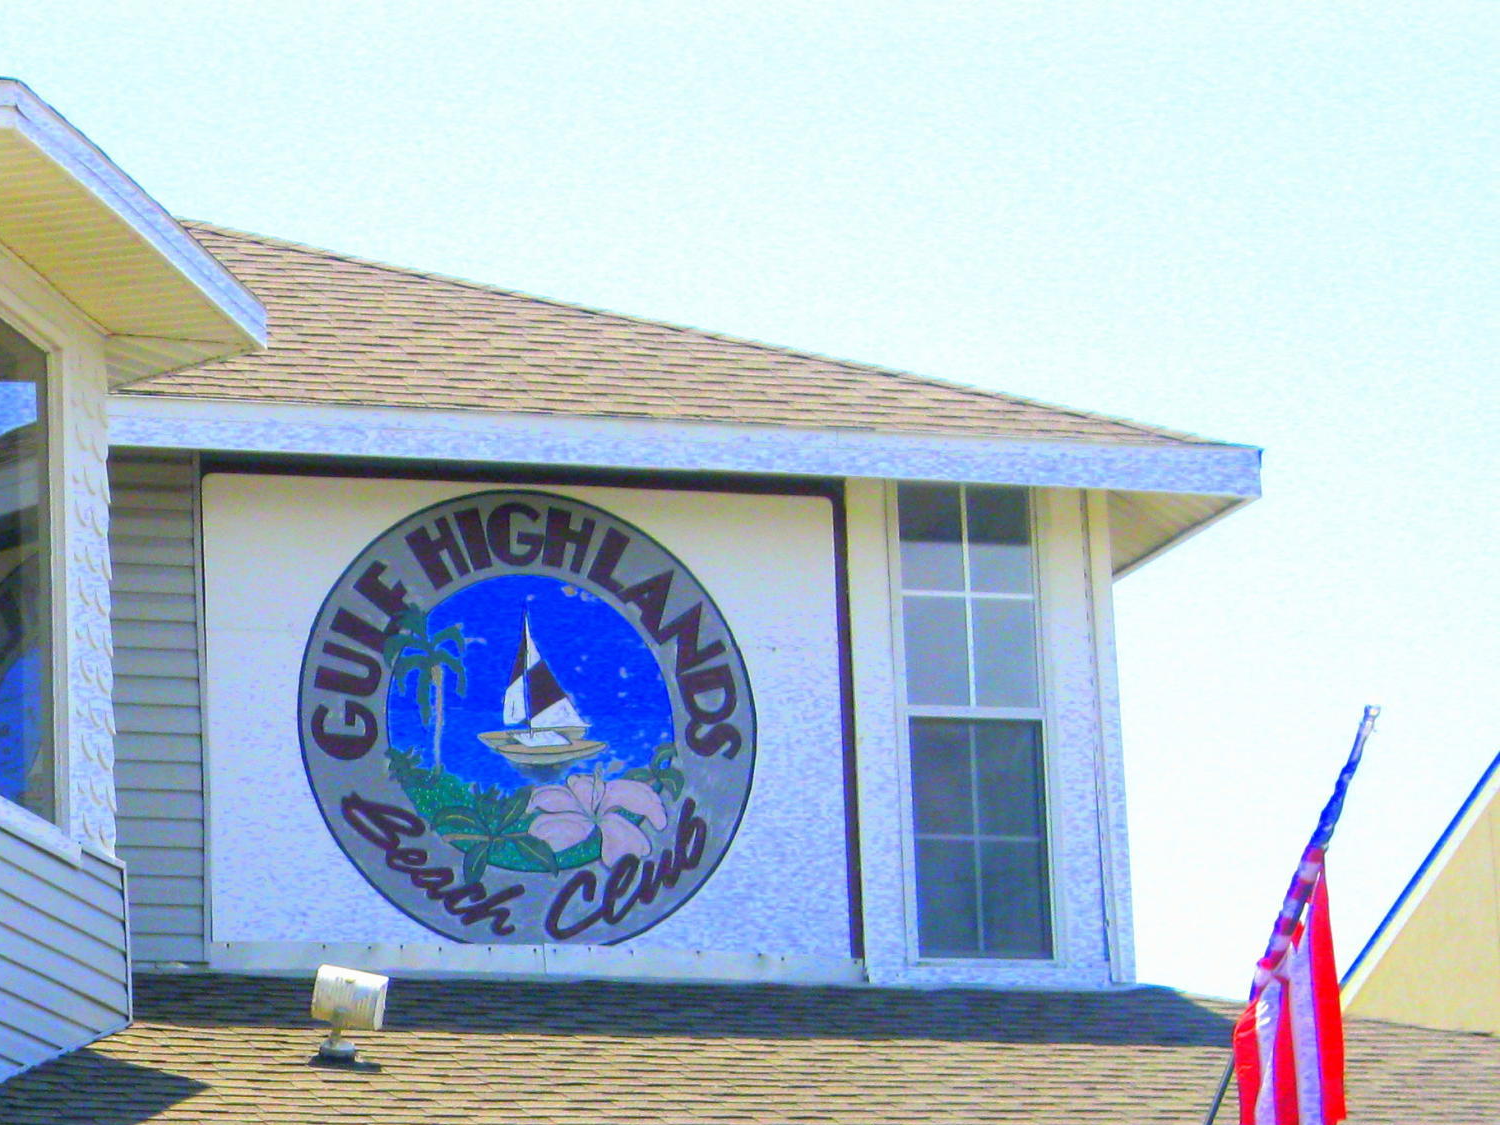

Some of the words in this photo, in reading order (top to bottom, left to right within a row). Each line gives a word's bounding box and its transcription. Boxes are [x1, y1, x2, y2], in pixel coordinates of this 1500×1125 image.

[311, 559, 409, 761] GULF
[404, 502, 742, 760] HIGHLANDS
[341, 791, 526, 936] Beach
[545, 797, 707, 940] Club
